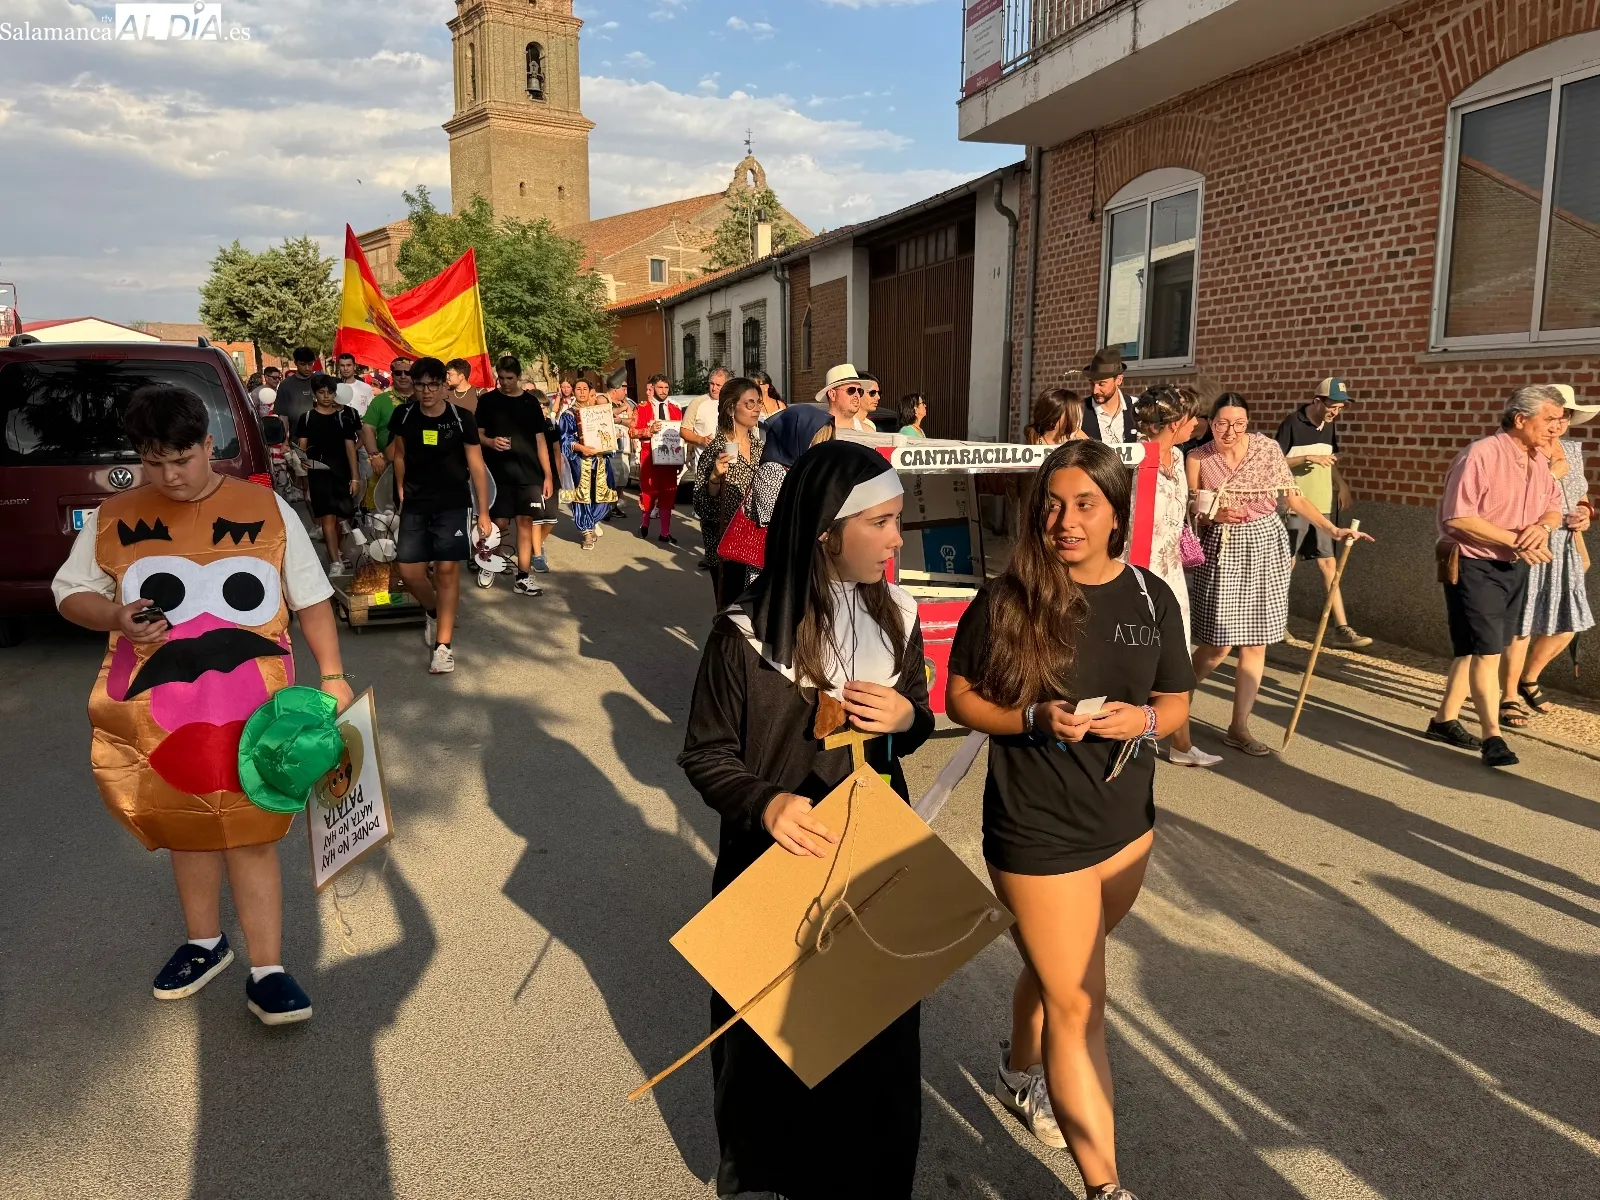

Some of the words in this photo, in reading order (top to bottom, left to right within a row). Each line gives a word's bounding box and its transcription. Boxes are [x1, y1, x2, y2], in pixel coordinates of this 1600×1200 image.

[323, 783, 365, 830] PATATA
[350, 800, 373, 827] MATA
[338, 818, 350, 835] NO
[352, 815, 380, 846] DONDE
[323, 830, 337, 851] HAY
[337, 836, 350, 855] NO
[321, 848, 336, 872] HAY
